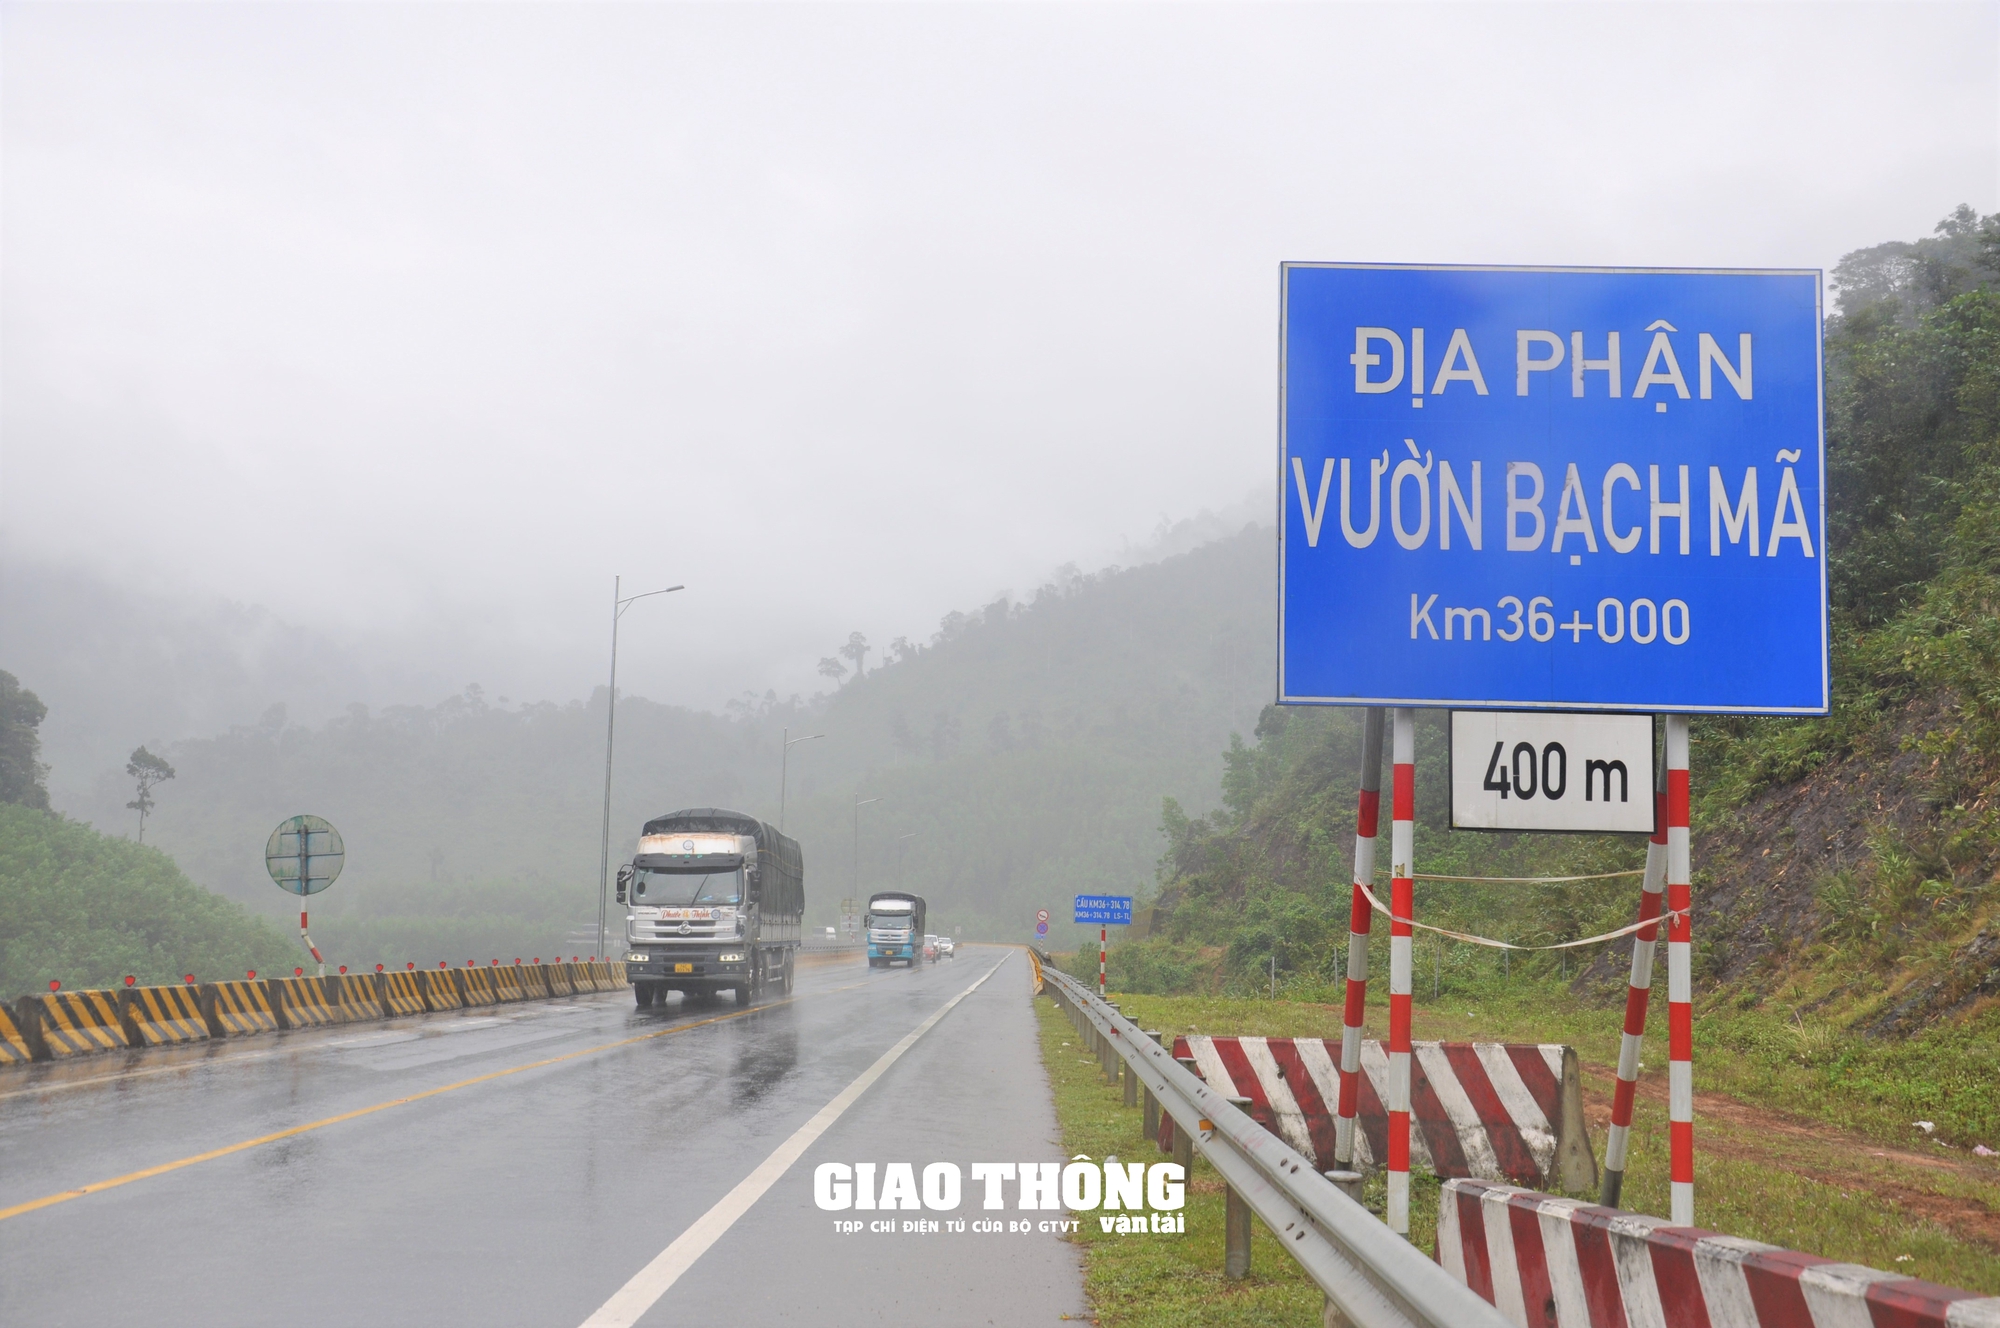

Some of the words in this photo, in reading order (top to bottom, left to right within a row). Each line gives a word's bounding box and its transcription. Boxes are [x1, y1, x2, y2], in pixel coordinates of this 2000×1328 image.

[1350, 326, 1489, 409] ĐỊA
[1516, 319, 1753, 413] PHẬN
[1291, 438, 1482, 551] VƯỜN
[1506, 461, 1690, 566] BẠCH
[1709, 448, 1815, 558] MÃ
[1410, 593, 1690, 645] Km36+000
[1483, 741, 1567, 801] 400
[1585, 759, 1628, 803] m
